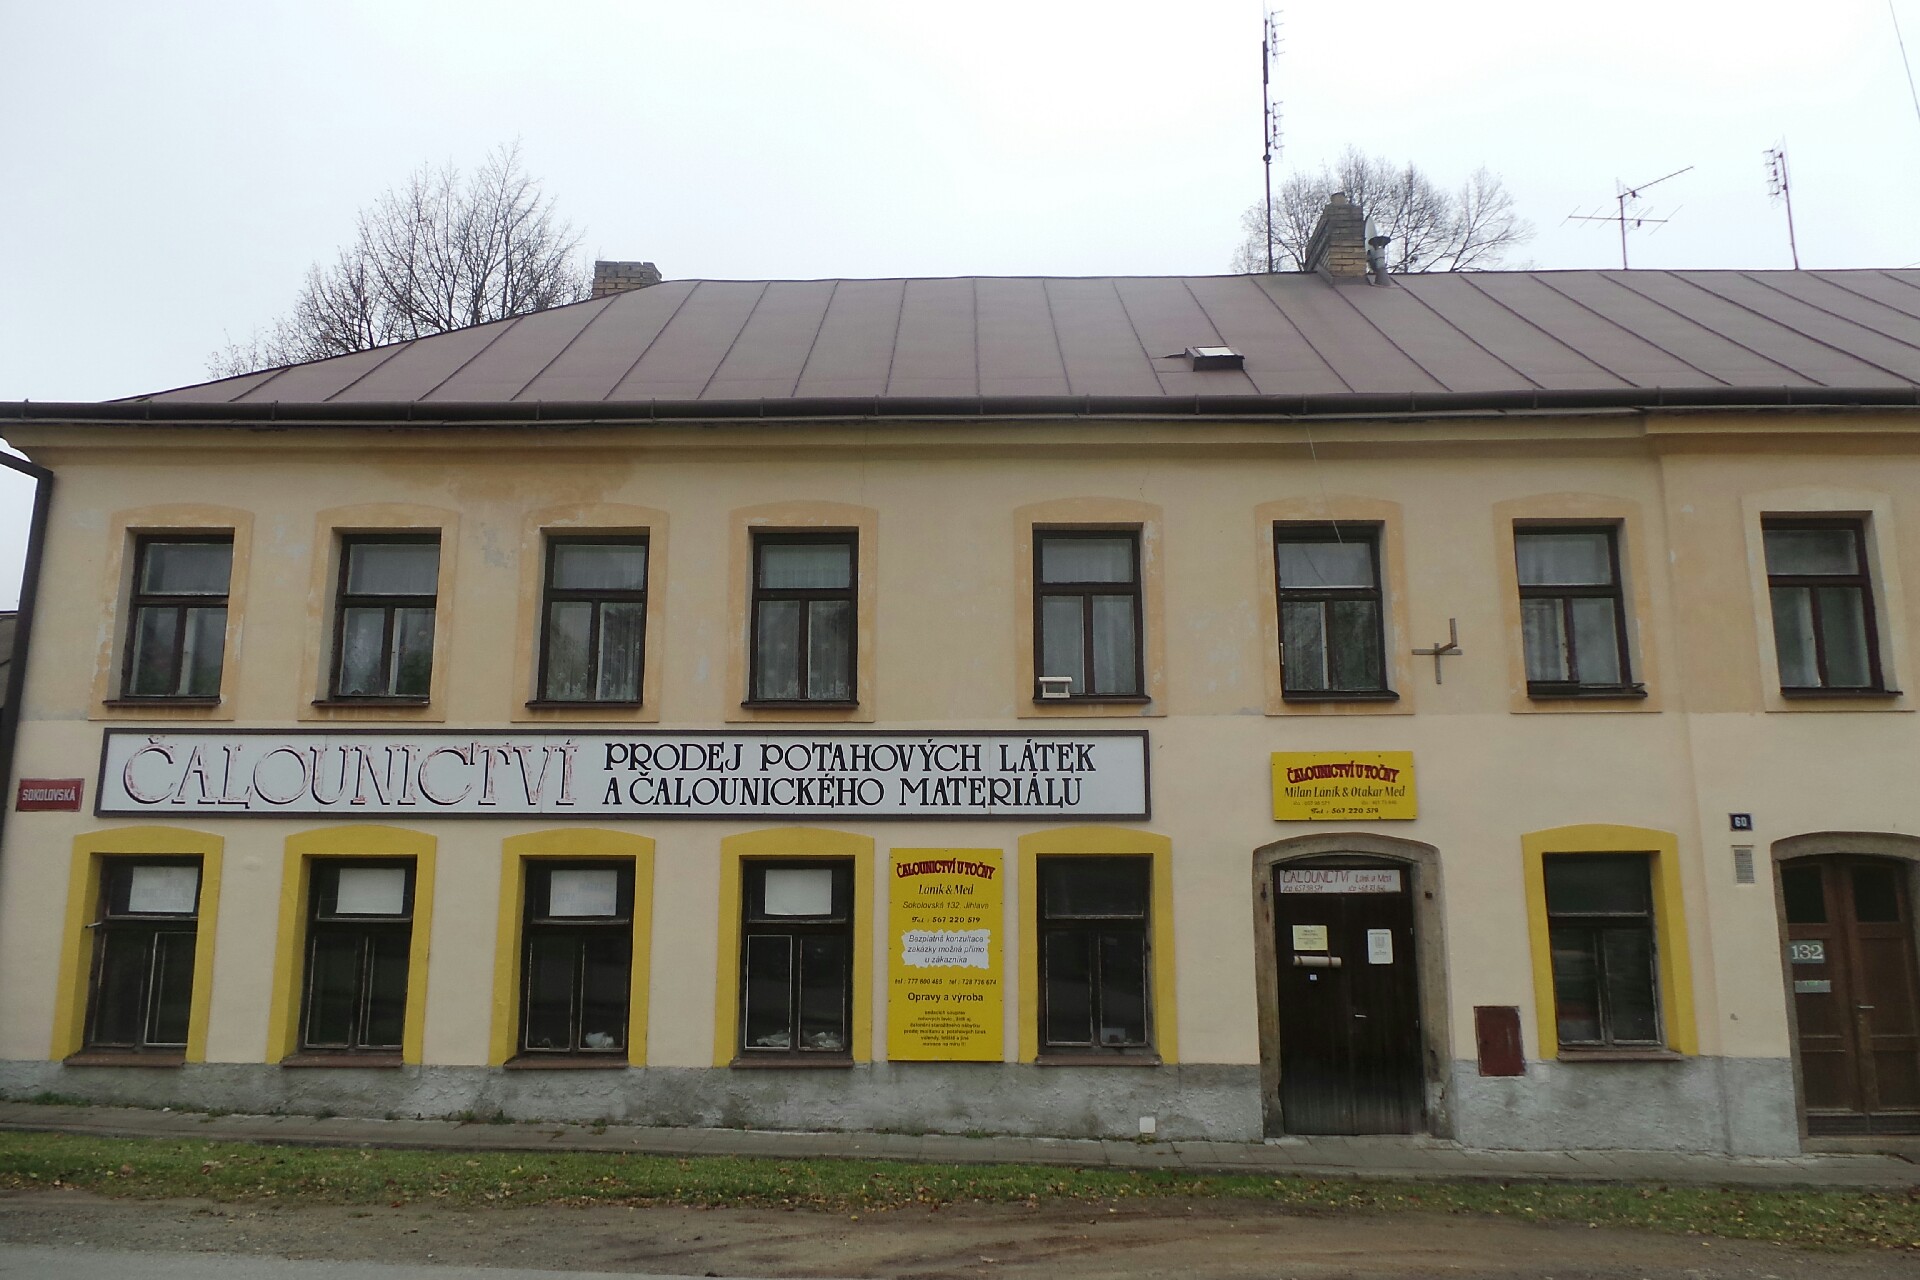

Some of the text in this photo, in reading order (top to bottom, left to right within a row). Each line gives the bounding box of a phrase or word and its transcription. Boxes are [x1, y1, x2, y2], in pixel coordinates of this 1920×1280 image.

[604, 739, 1096, 773] PRODEJ POTAHOVÝCH LÁTEK
[123, 737, 578, 809] ČALOUNICTVÍ
[22, 786, 76, 801] SOKOLOVSKÁ
[602, 771, 1082, 808] A ČALOUNICKÉHO MATERIÁLU
[1284, 786, 1312, 797] Milan
[1342, 787, 1349, 797] &
[1351, 785, 1383, 797] Otakar
[1385, 785, 1406, 797] Med
[1734, 816, 1748, 827] 60
[945, 884, 953, 895] &
[954, 883, 974, 895] Med
[902, 901, 944, 909] Sokolovská
[945, 934, 984, 943] konzultace
[1791, 944, 1824, 960] 132
[907, 992, 941, 1003] Opravy
[951, 992, 984, 1003] výroba
